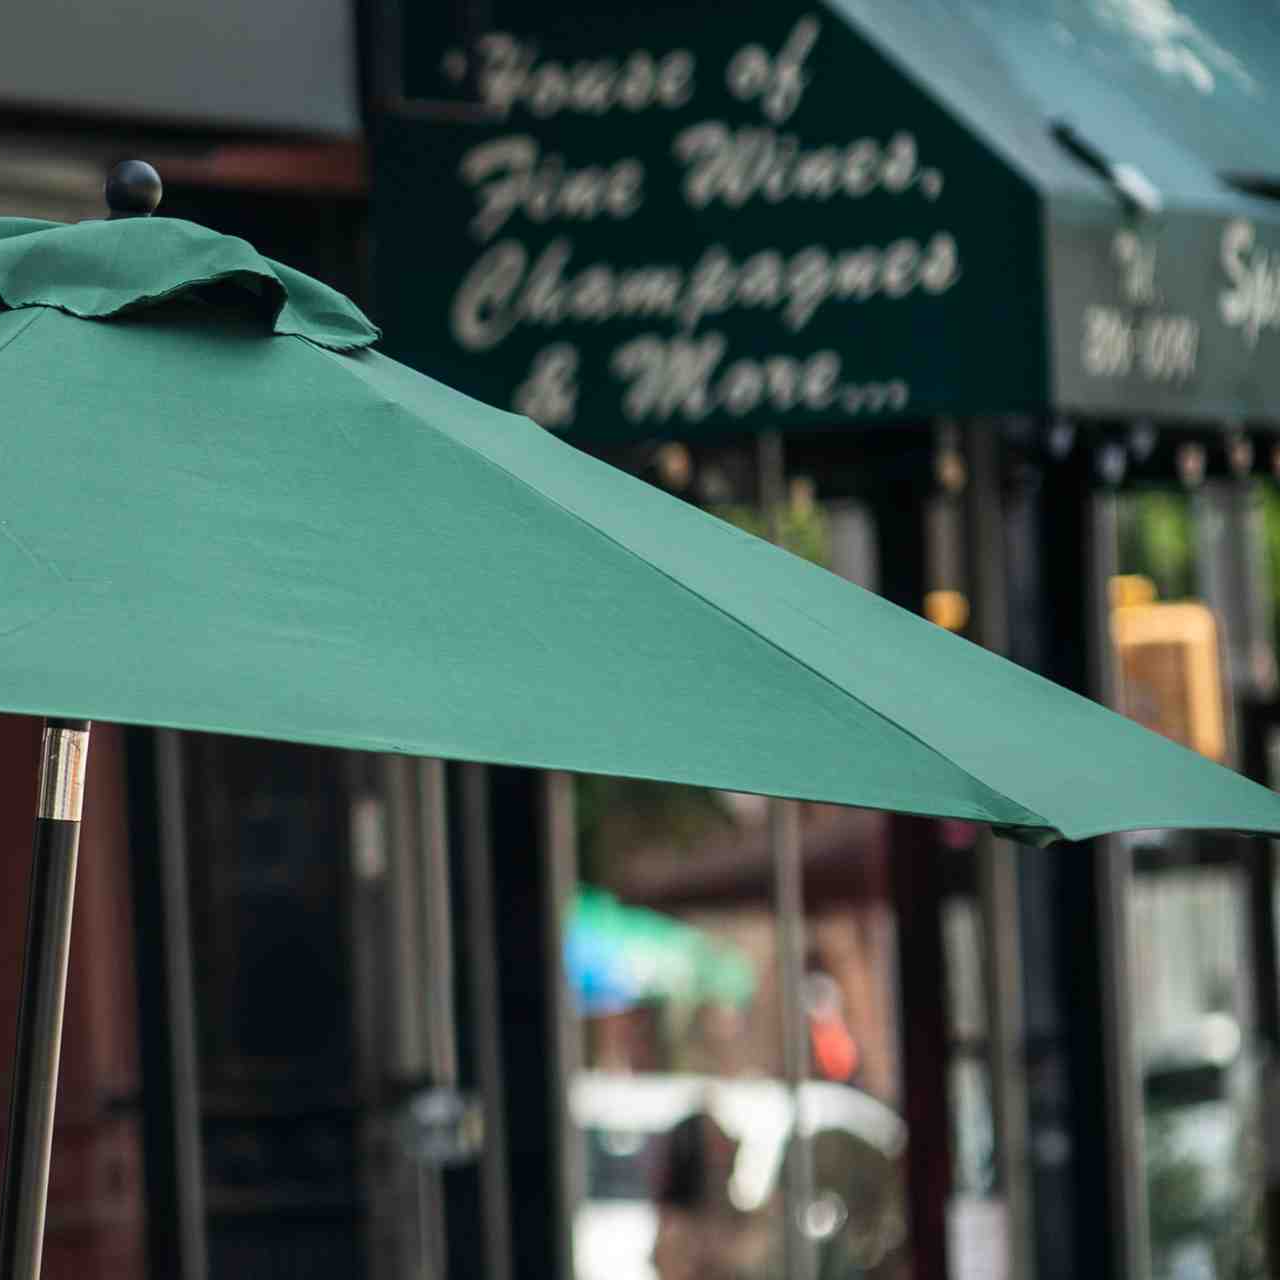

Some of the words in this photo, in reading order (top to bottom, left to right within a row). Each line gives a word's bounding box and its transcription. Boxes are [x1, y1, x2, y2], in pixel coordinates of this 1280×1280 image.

[443, 30, 696, 117] House
[725, 14, 821, 124] of
[458, 133, 646, 240] Fine
[450, 229, 962, 353] Champagnes
[514, 342, 579, 428] &
